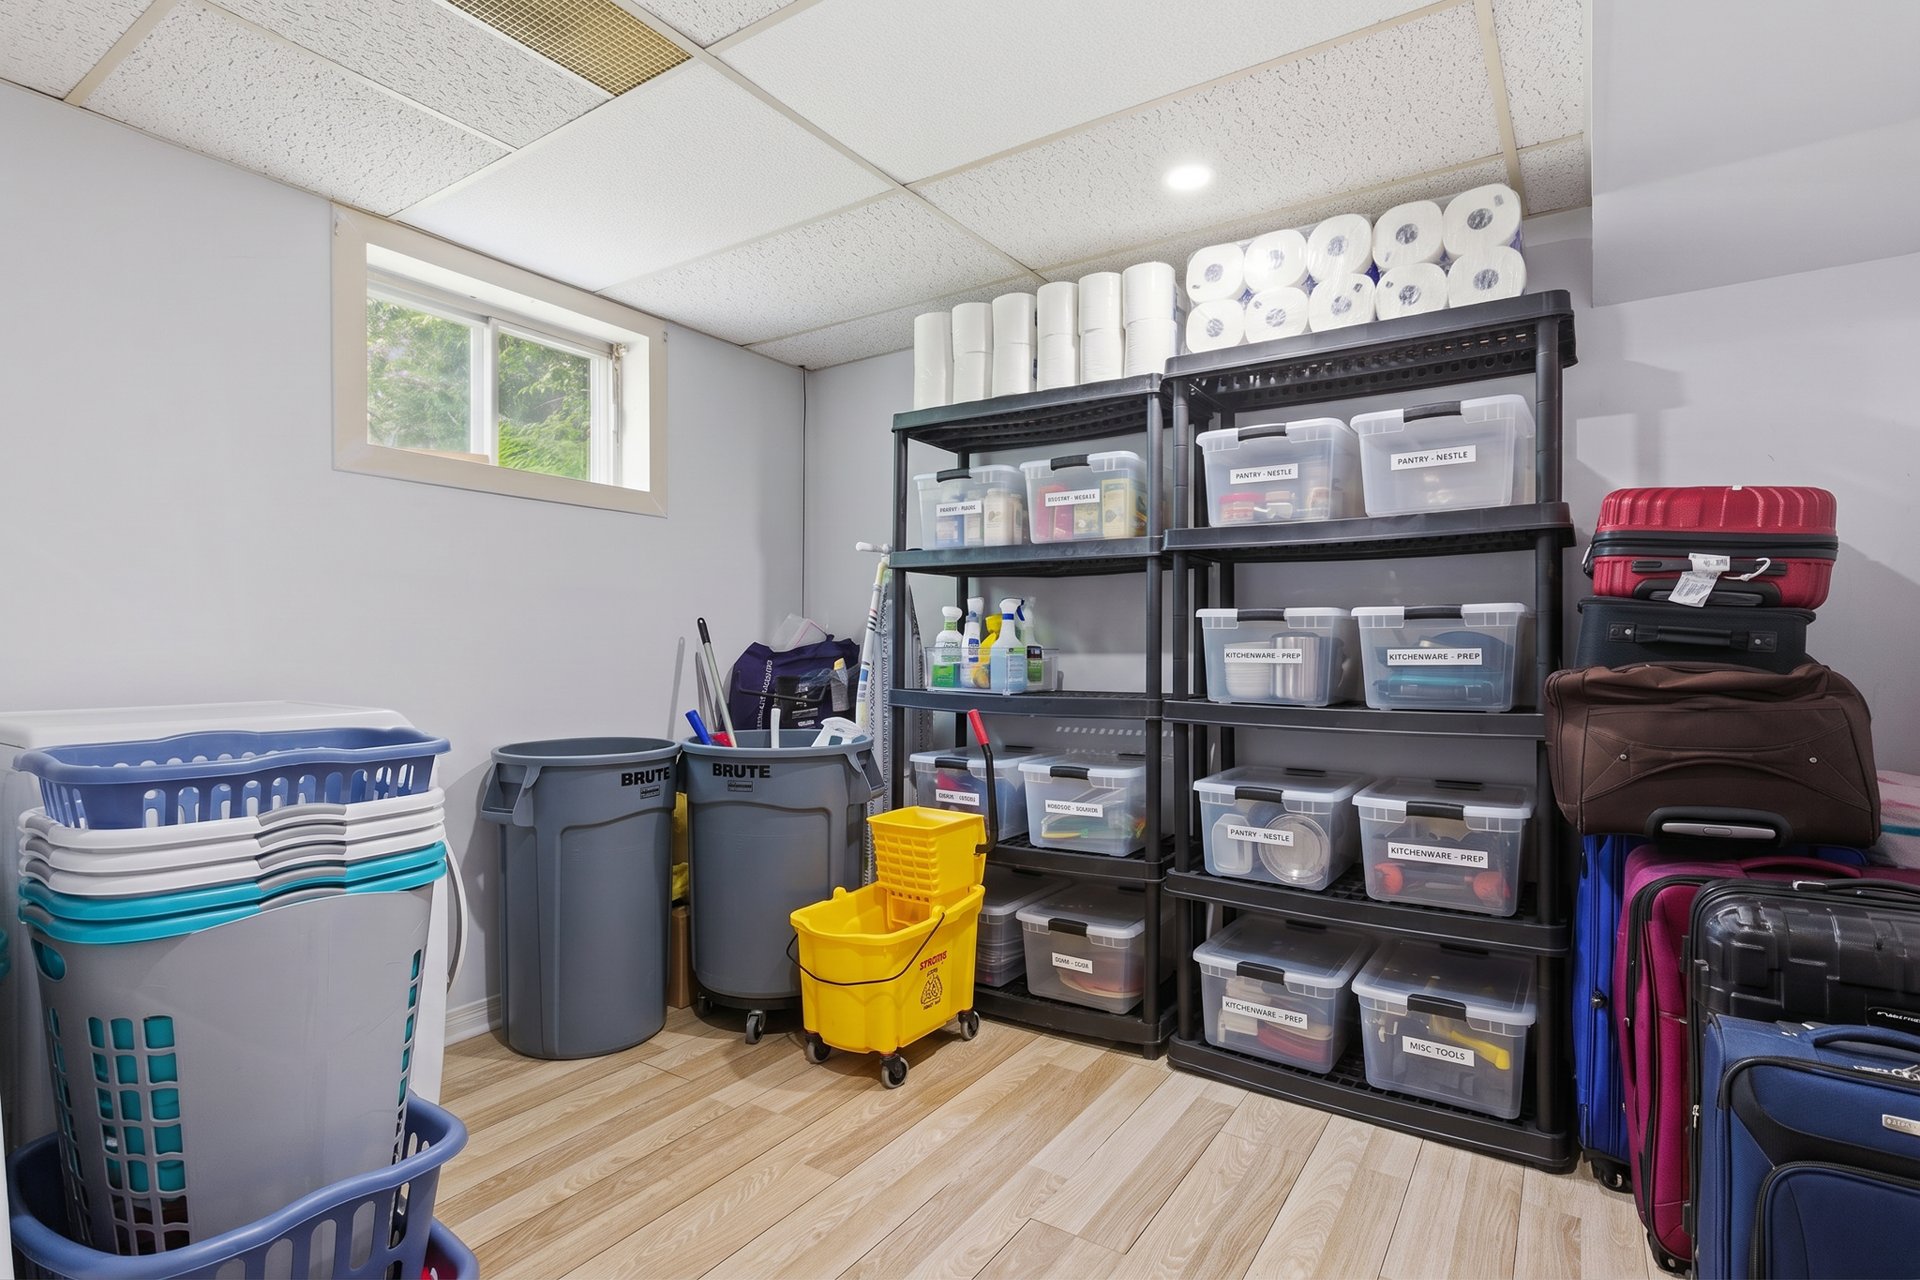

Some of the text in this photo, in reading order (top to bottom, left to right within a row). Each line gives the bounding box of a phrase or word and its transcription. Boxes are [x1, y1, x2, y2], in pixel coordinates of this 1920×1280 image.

[1397, 455, 1429, 465] PANTRY
[1436, 451, 1468, 461] NESTLE
[1235, 471, 1261, 479] PANTRY
[1267, 468, 1292, 477] NESTLE
[1457, 652, 1480, 660] PREP
[621, 766, 670, 786] BRUTE
[712, 763, 771, 778] BRUTE
[1230, 829, 1257, 837] PANTRY
[1263, 833, 1290, 842] NESTLE
[1390, 847, 1452, 860] KITCHENWARE
[1460, 854, 1484, 863] PREP
[1225, 1001, 1277, 1019] KITCHENWARE
[1284, 1014, 1304, 1024] PREP
[1410, 1041, 1465, 1061] MISC TOOLS
